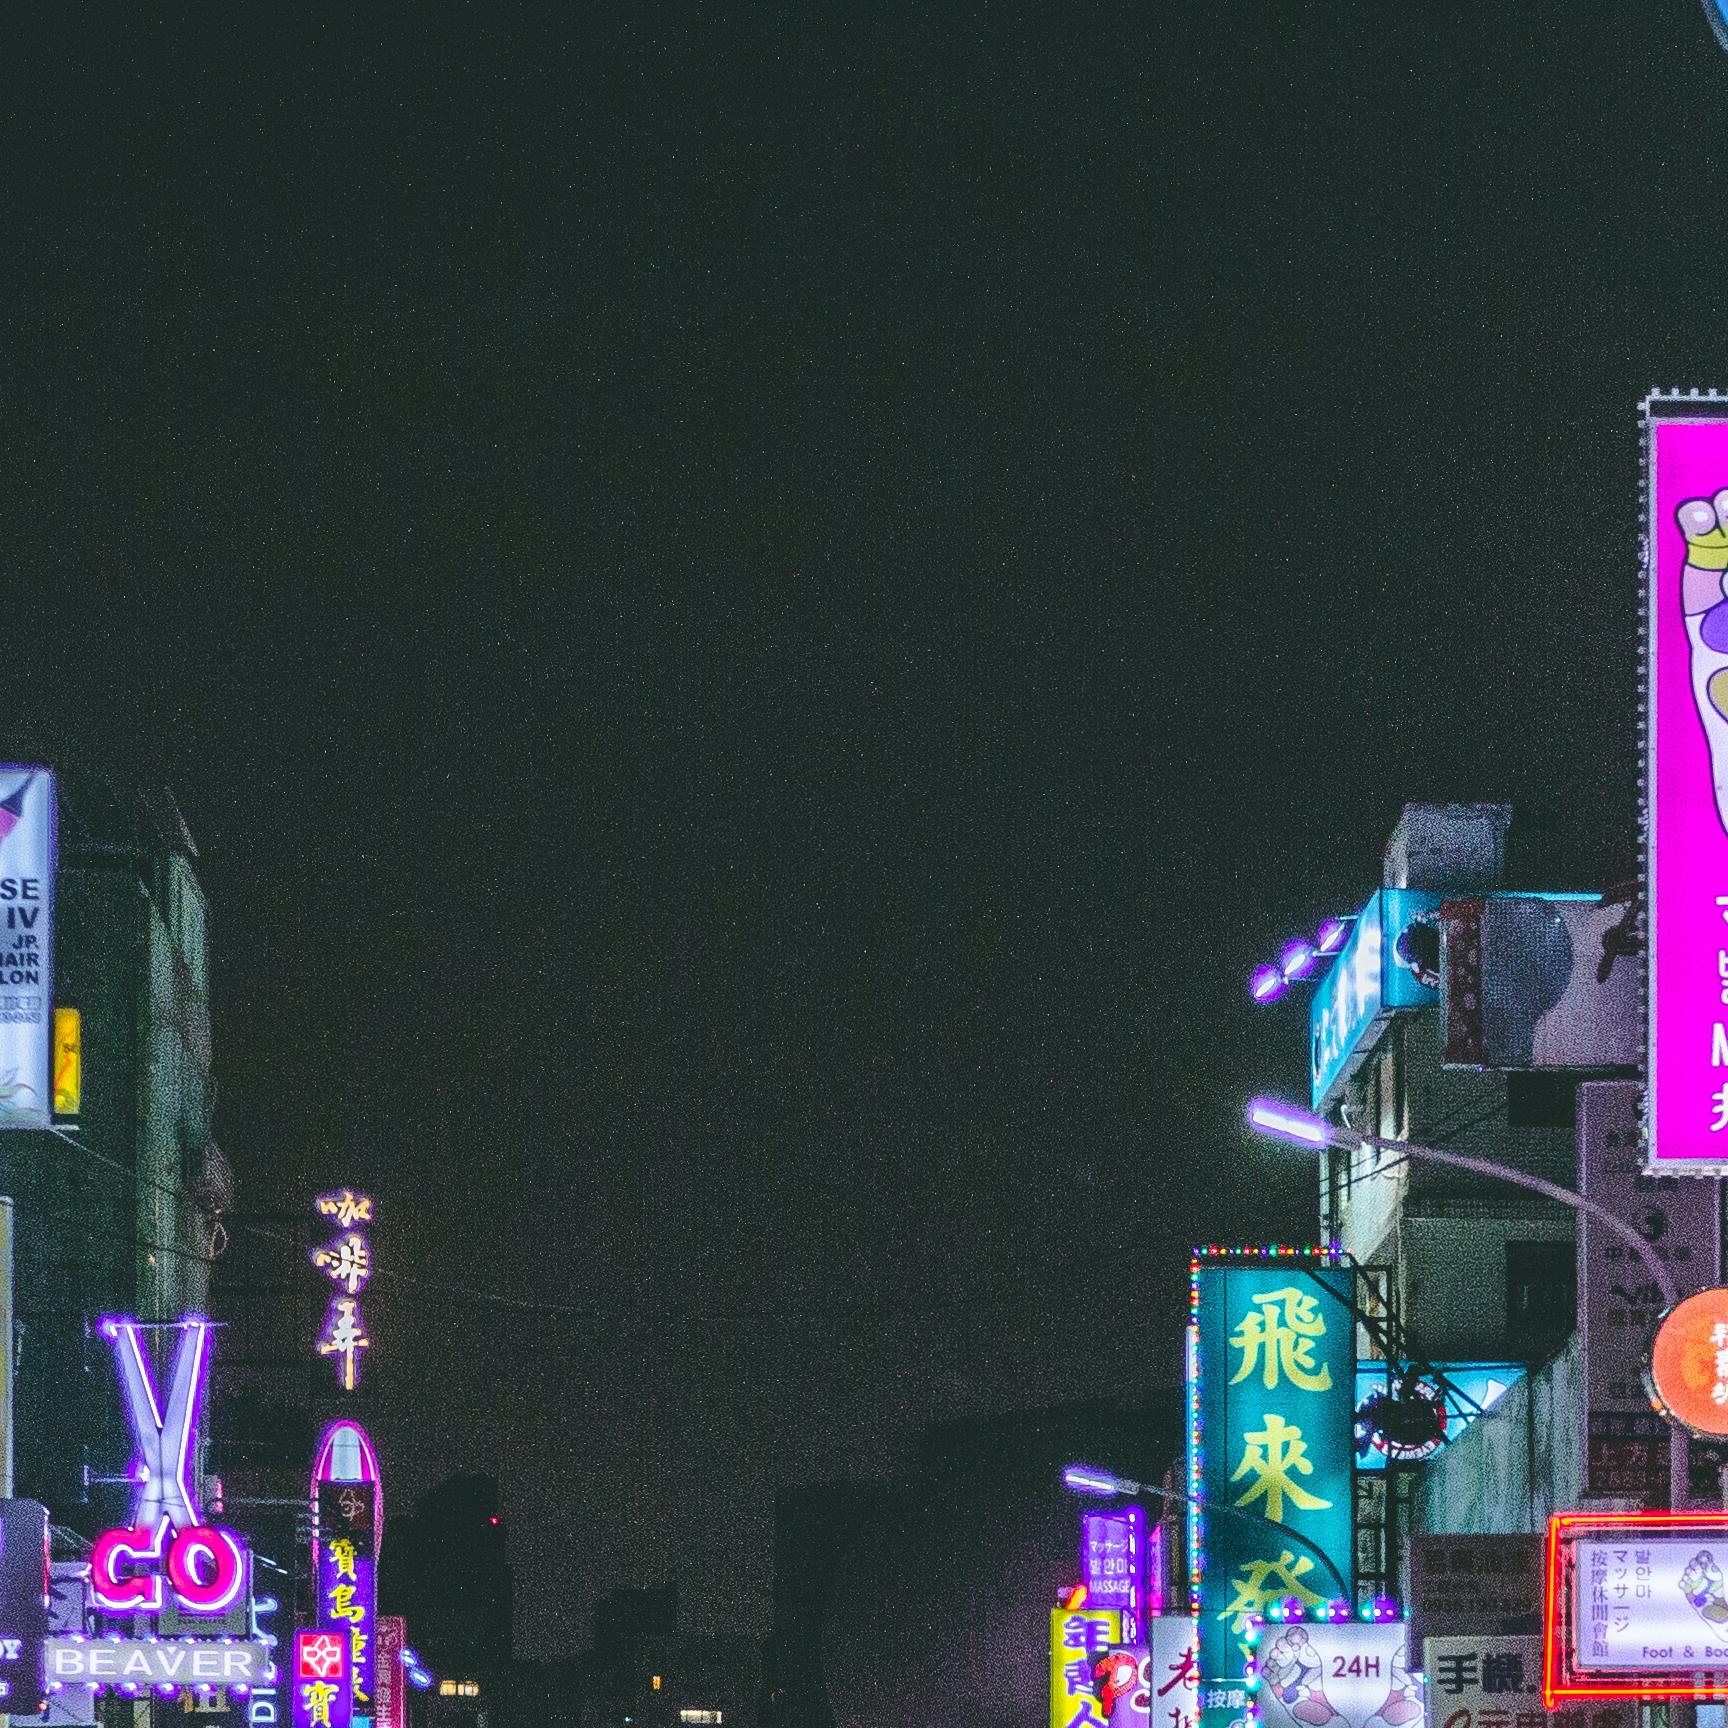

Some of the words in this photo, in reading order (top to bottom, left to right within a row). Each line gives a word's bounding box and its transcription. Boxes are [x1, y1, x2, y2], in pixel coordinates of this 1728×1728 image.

[6, 908, 39, 929] IV
[1634, 1549, 1652, 1599] 발안마
[1612, 1549, 1631, 1634] マッサージ
[53, 1647, 254, 1678] BEAVER
[1642, 1645, 1673, 1659] Foot
[1683, 1645, 1695, 1658] &
[1331, 1656, 1381, 1678] 24H
